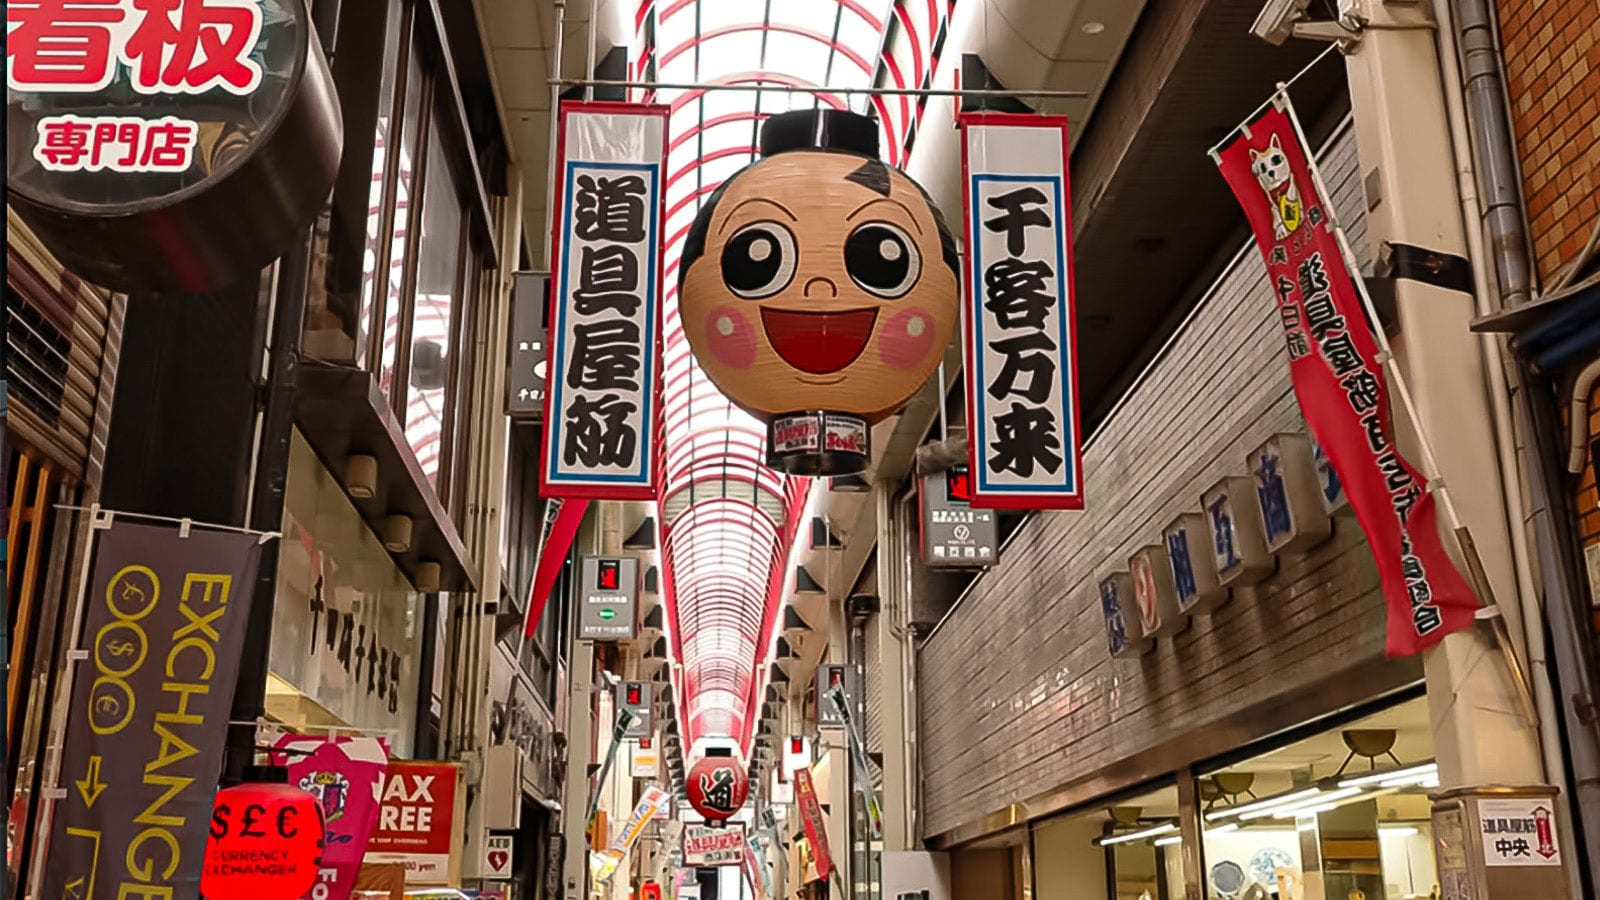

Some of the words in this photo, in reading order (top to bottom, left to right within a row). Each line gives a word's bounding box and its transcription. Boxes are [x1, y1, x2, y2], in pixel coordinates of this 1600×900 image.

[7, 0, 255, 88] 看板
[40, 121, 193, 167] 専門店
[563, 173, 648, 469] 道具屋筋
[984, 186, 1064, 479] 千客万来
[117, 572, 233, 900] EXCHANGE
[381, 774, 436, 803] AX
[701, 766, 739, 813] 道
[240, 804, 267, 838] £
[277, 805, 299, 839] €
[379, 805, 433, 832] REE
[1495, 837, 1531, 858] 中央
